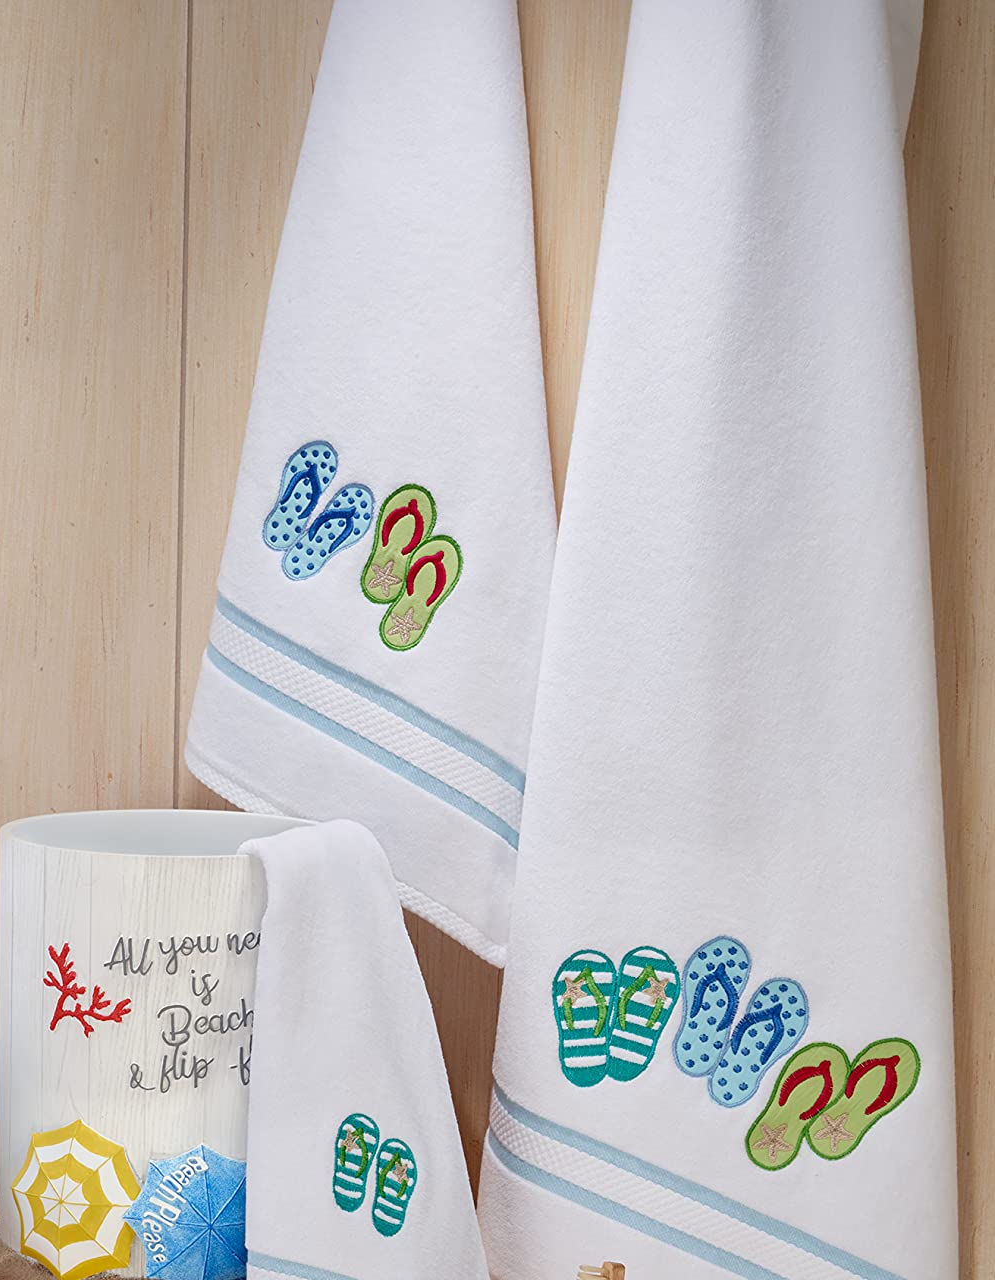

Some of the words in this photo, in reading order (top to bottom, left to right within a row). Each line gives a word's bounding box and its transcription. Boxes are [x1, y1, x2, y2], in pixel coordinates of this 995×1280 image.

[104, 936, 154, 976] All
[158, 934, 220, 975] you
[190, 969, 220, 1007] is
[129, 1063, 156, 1091] &
[159, 1045, 215, 1094] flip
[155, 1156, 210, 1203] Beach
[141, 1195, 182, 1263] Please
